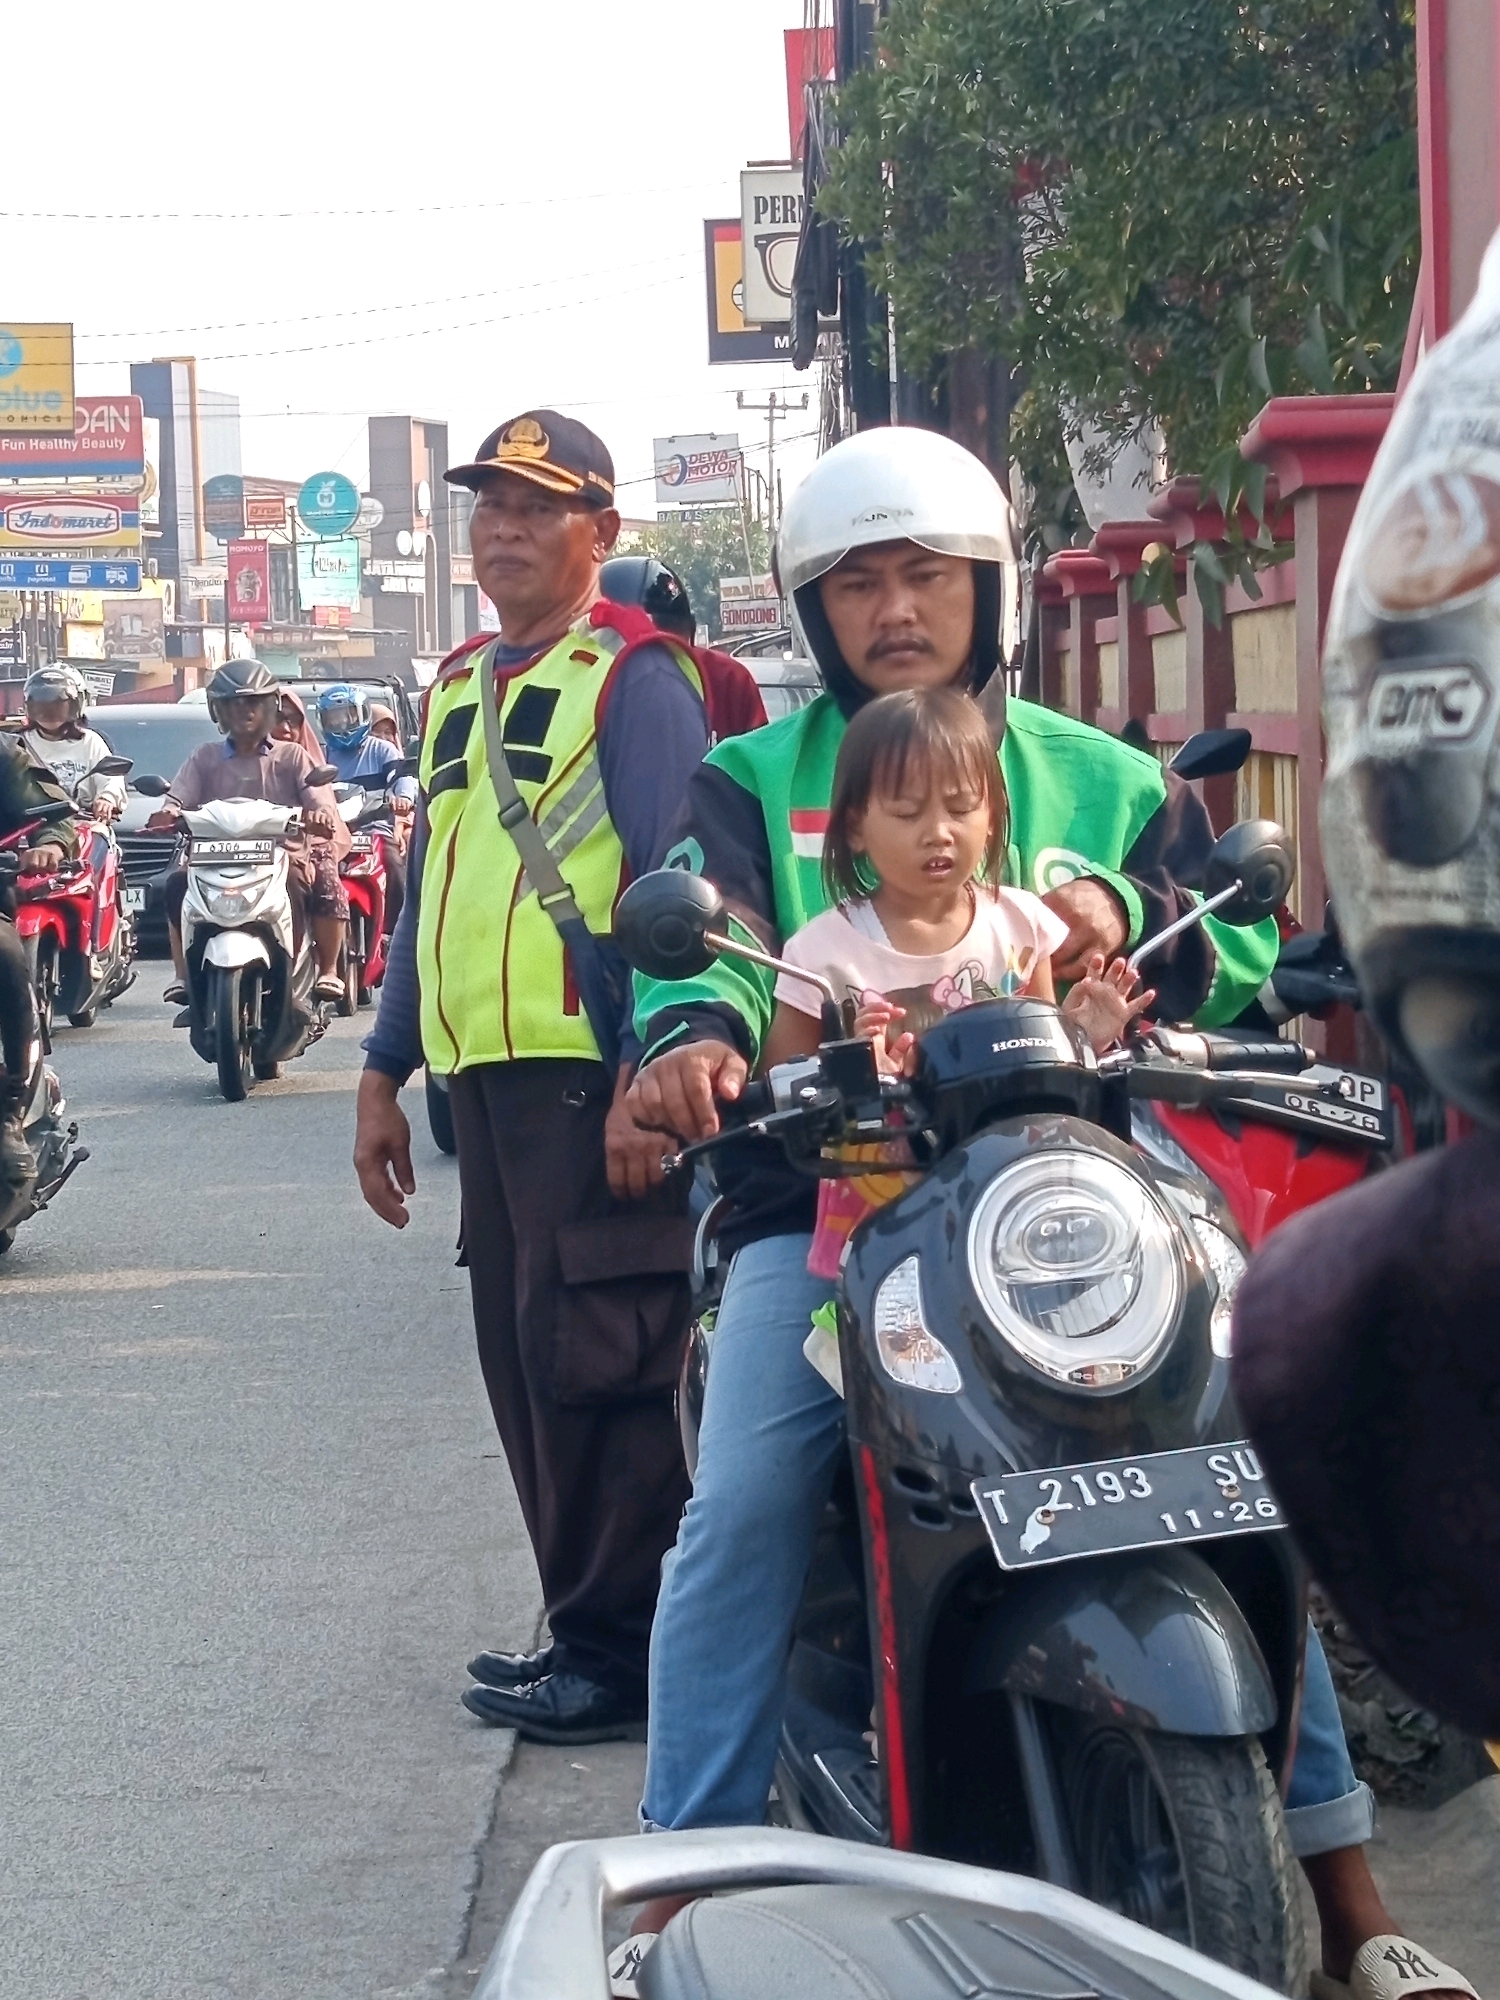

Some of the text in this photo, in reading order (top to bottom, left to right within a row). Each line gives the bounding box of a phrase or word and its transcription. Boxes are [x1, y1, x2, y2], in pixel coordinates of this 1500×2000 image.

[1, 437, 126, 453] Fun Healthy Beauty
[689, 450, 728, 464] DEWA
[688, 460, 737, 477] MOTOR
[15, 510, 116, 529] Indomaret
[982, 1489, 1009, 1525] T
[1039, 1466, 1153, 1511] 2193
[1383, 1945, 1439, 1979] NY
